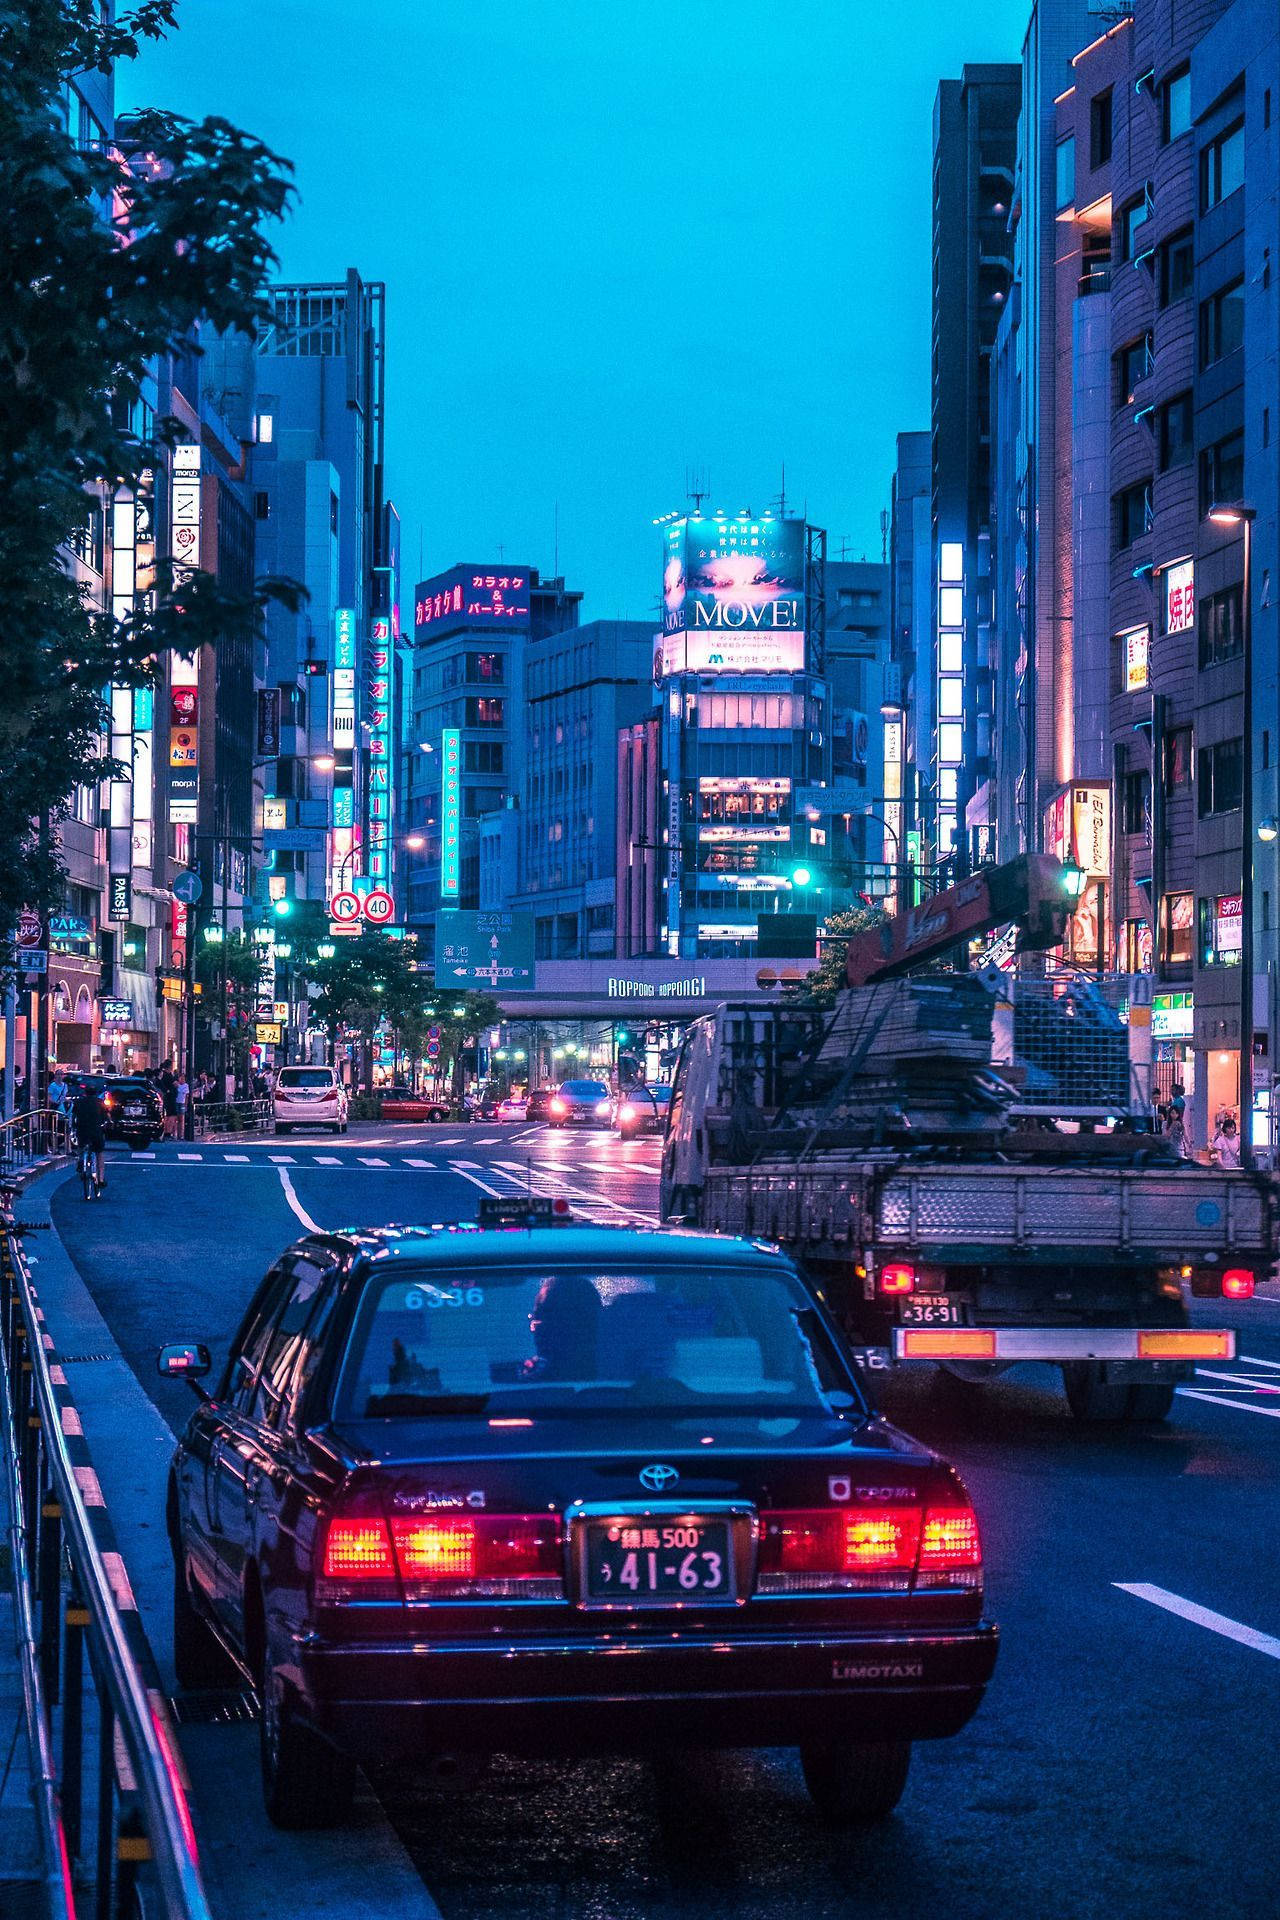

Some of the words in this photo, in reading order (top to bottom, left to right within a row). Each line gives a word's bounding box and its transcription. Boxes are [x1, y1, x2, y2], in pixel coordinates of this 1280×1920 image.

[472, 576, 523, 588] カラオケ
[492, 590, 502, 601] &
[694, 600, 798, 627] MOVE!
[115, 878, 126, 908] PARS
[370, 901, 387, 914] 40
[486, 1205, 549, 1213] LIMOTXI
[913, 1306, 958, 1322] 36-91
[621, 1529, 660, 1549] 練馬
[662, 1528, 699, 1549] 500
[620, 1551, 722, 1591] 41-63
[832, 1664, 923, 1679] LIMOTAXI
